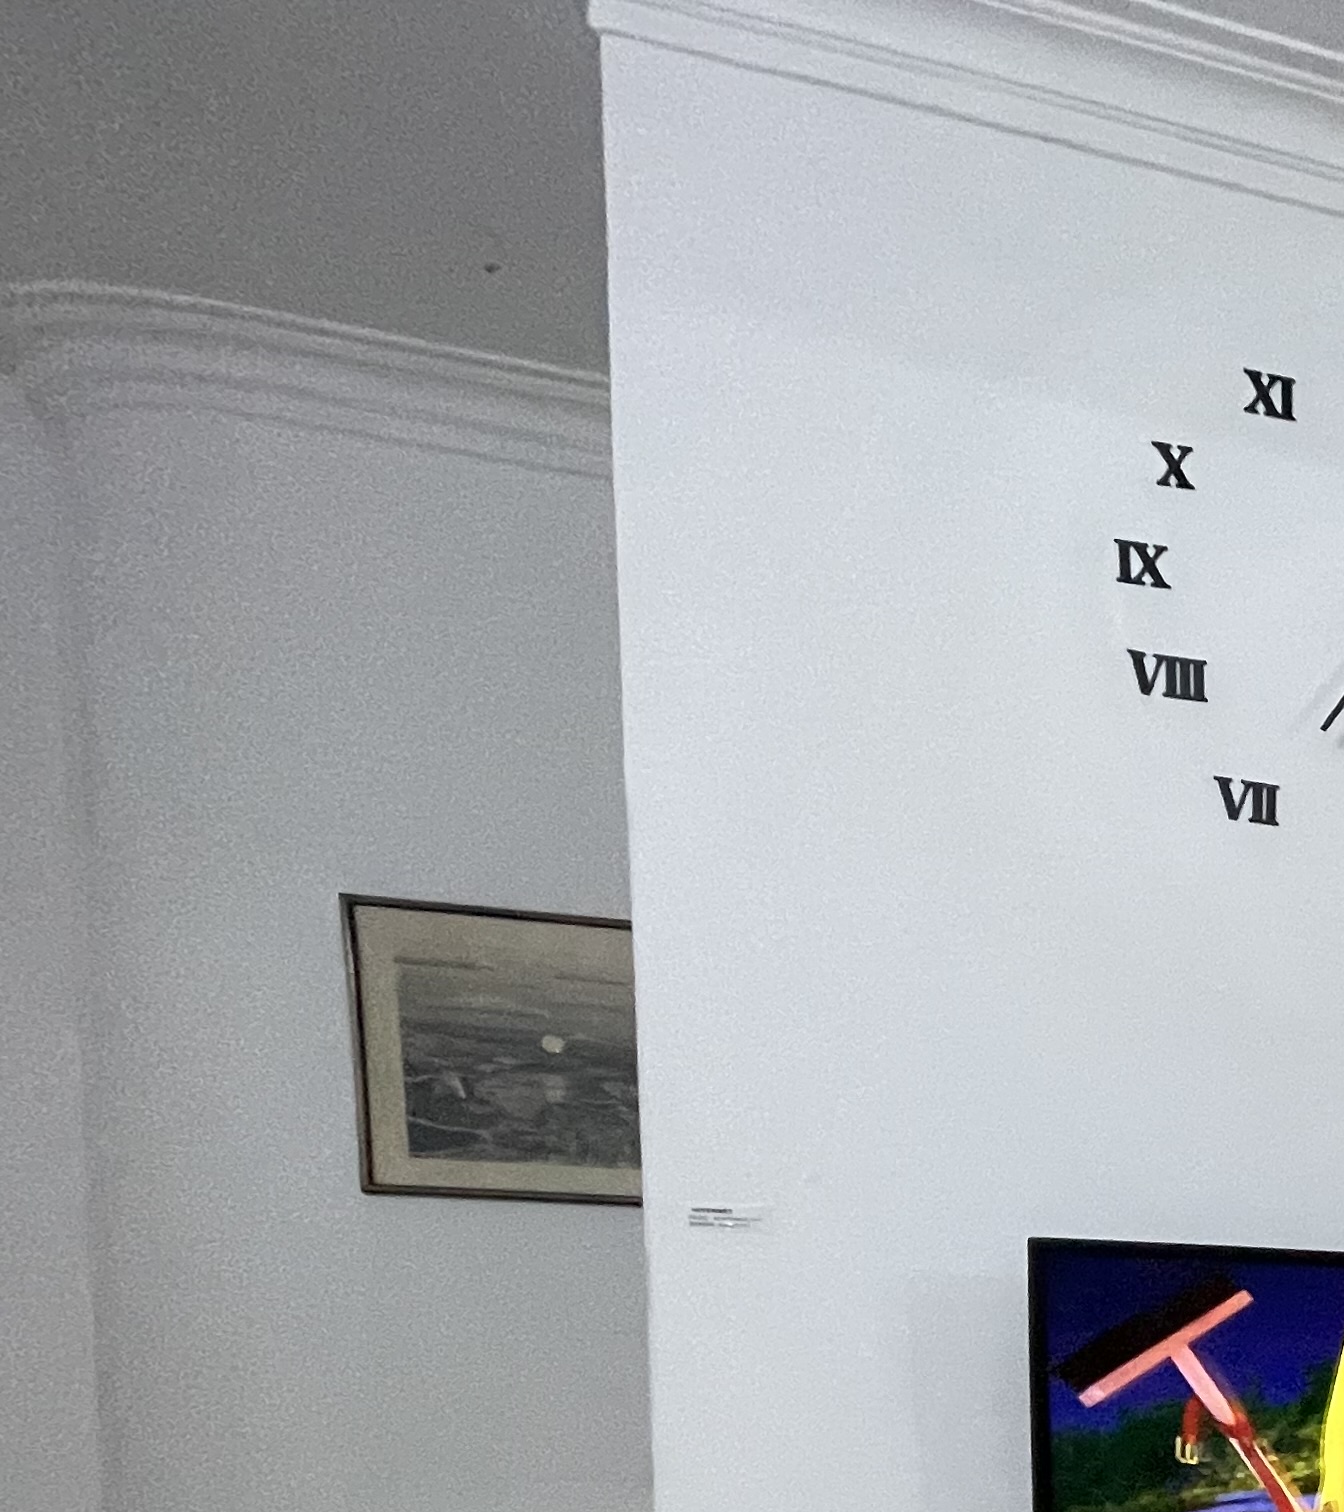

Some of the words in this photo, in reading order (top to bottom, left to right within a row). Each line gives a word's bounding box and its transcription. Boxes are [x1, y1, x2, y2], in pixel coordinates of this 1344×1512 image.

[1243, 367, 1297, 422] XI
[1151, 440, 1196, 490] X
[1113, 538, 1171, 589] IX
[1126, 648, 1208, 703] VIII
[1213, 775, 1280, 827] VII
